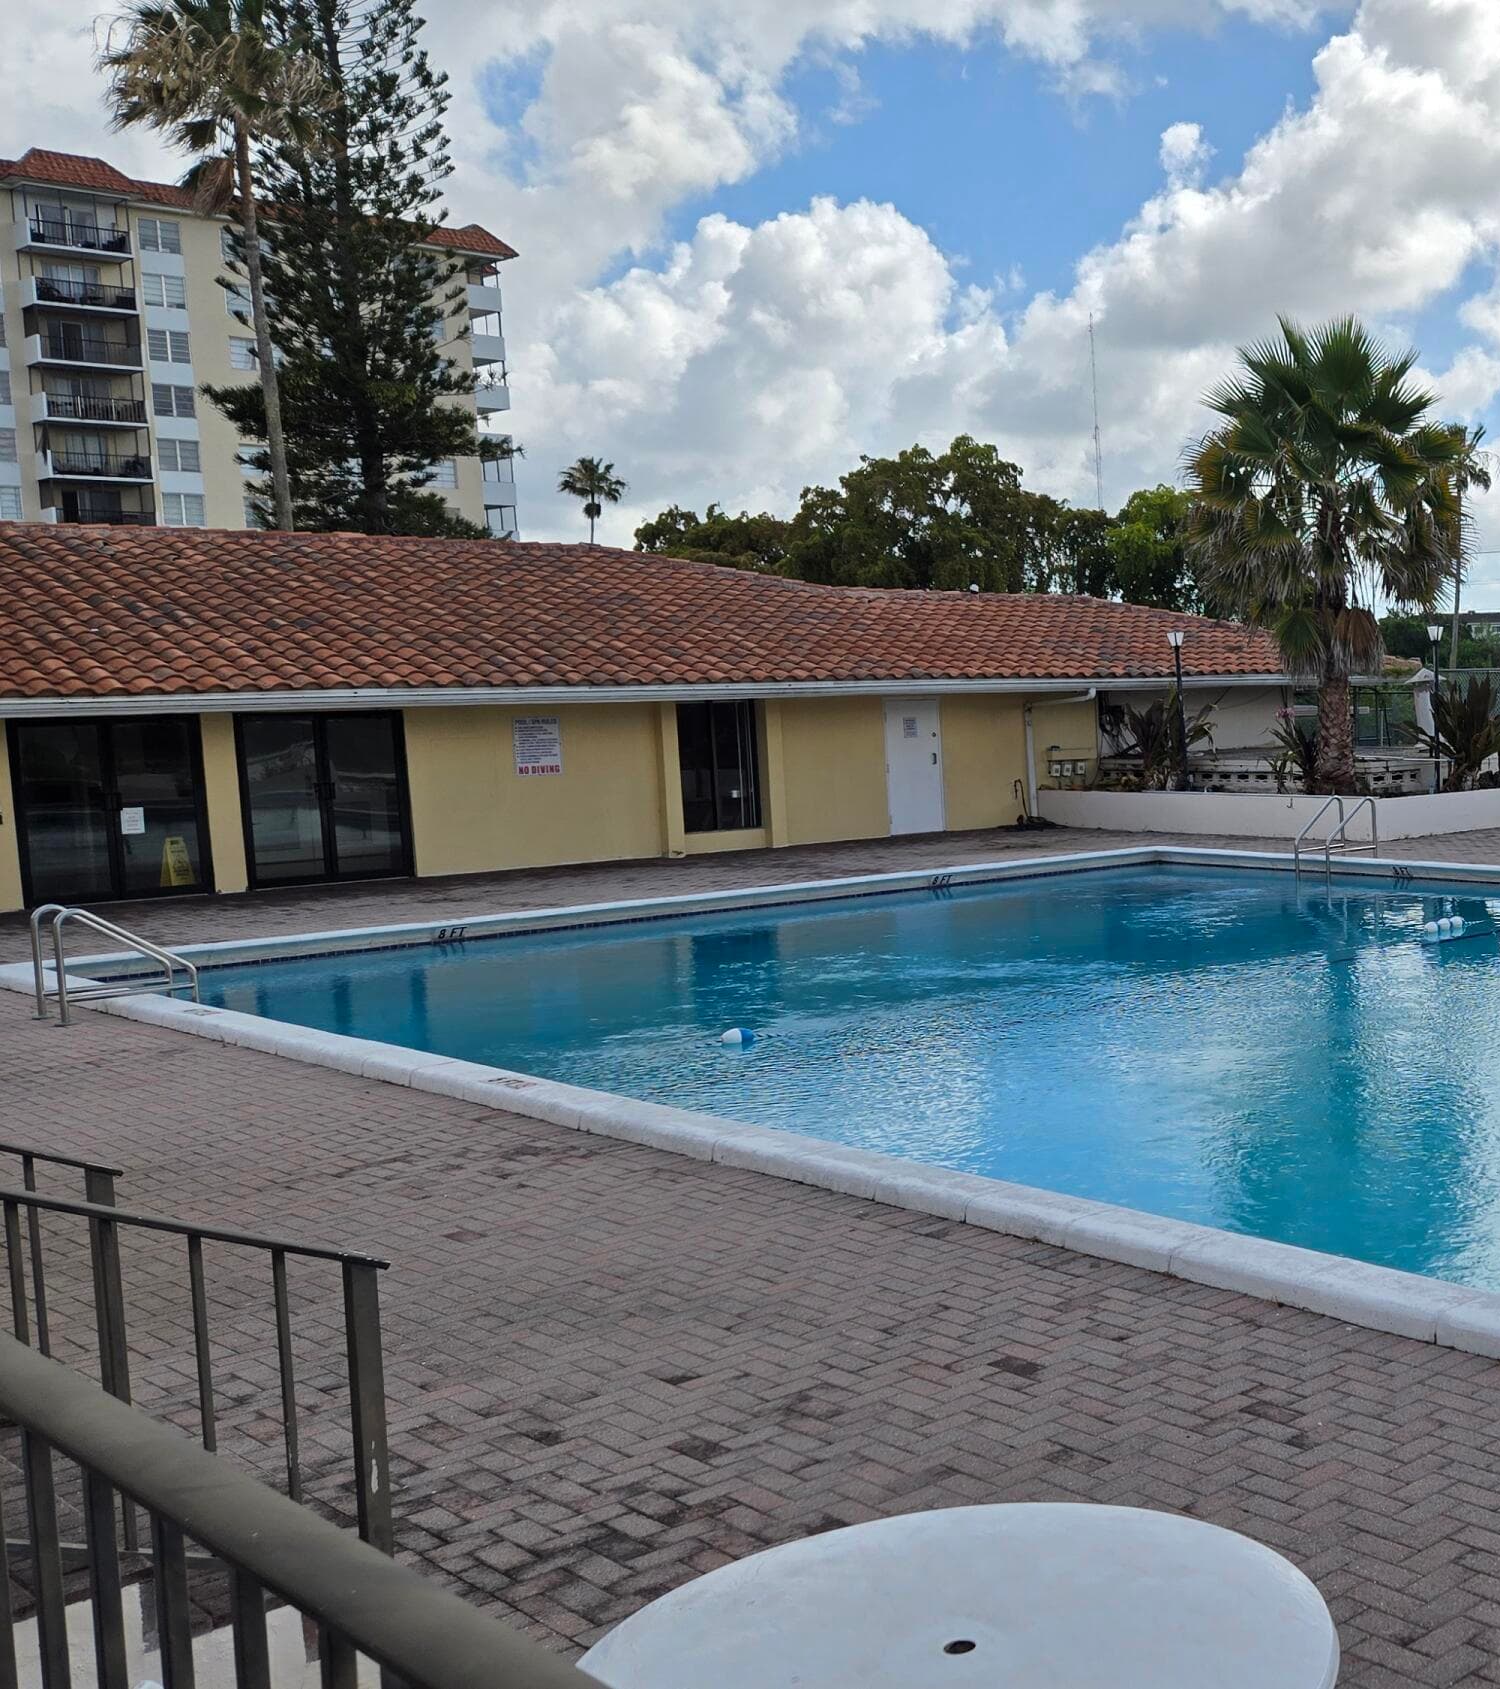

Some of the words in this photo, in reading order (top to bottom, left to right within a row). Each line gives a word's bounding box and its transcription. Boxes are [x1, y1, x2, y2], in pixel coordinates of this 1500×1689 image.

[518, 766, 529, 775] NO
[531, 765, 560, 774] DIVING
[940, 874, 953, 885] FT
[438, 928, 447, 939] 8
[449, 926, 467, 938] FT
